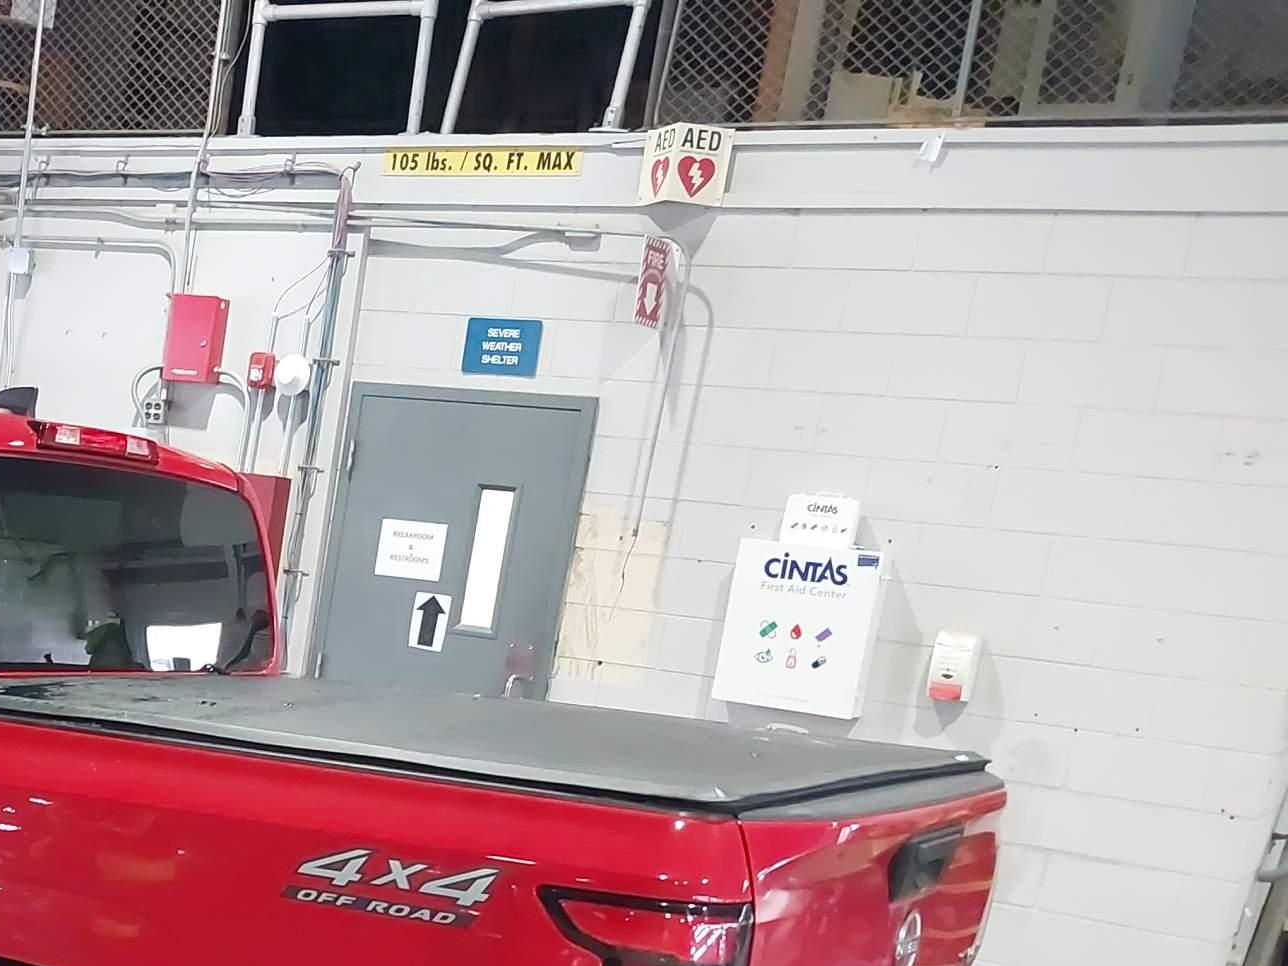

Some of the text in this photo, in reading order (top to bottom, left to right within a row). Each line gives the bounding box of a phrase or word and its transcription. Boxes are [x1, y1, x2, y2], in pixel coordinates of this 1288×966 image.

[655, 128, 676, 153] AED
[681, 127, 722, 152] AED
[391, 152, 576, 173] 105 lbs. / SQ. FT. MAX
[487, 328, 521, 339] SEVERE
[482, 341, 522, 352] WEATHER
[481, 354, 519, 365] SHELTER
[760, 581, 847, 600] First Aid Center
[296, 889, 457, 925] OFF ROAD
